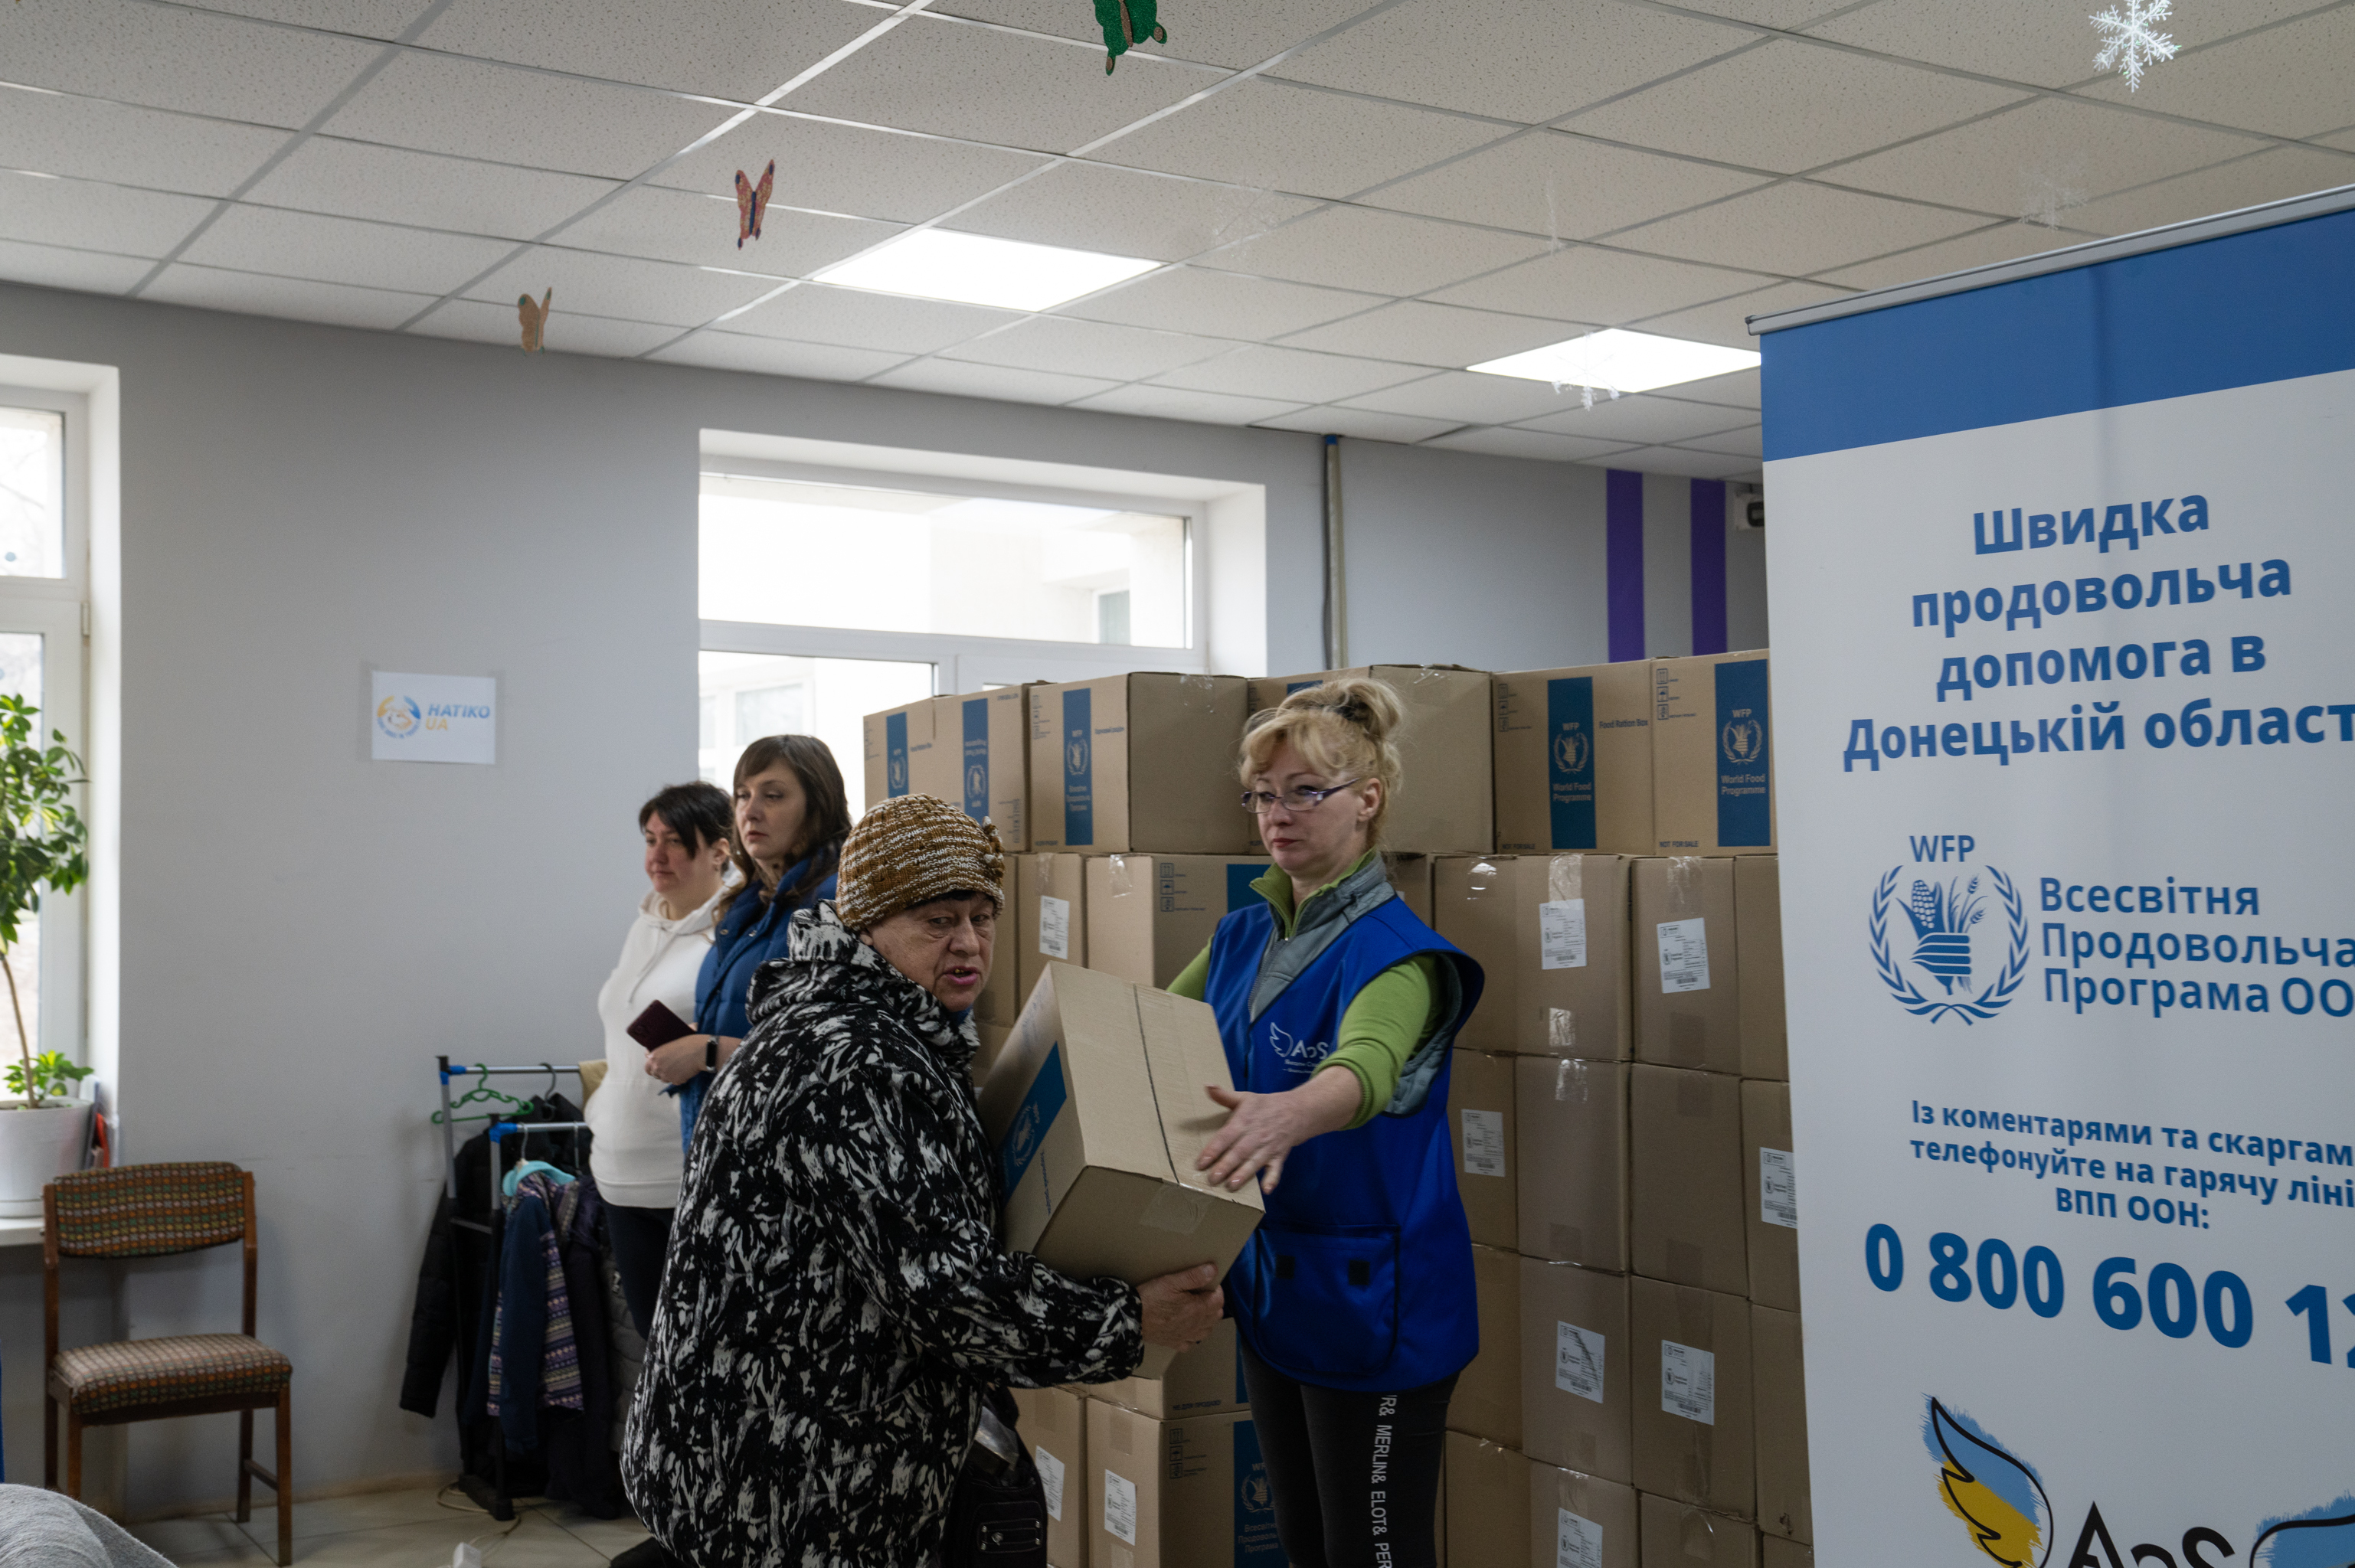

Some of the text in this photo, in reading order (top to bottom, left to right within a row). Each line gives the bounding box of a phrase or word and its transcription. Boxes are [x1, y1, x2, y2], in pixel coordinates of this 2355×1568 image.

[1974, 495, 2209, 555] Швидка
[1913, 559, 2291, 639] продовольча
[1936, 635, 2266, 703] допомога в
[426, 718, 448, 730] UA
[428, 704, 490, 718] HATIKO
[1562, 722, 1579, 731] WFP
[1599, 718, 1648, 729] Food Ration Box
[1732, 708, 1752, 718] WFP
[1843, 697, 2355, 773] Донецькій област
[1552, 782, 1592, 792] World Food
[1552, 793, 1592, 804] Programme
[1720, 773, 1766, 784] World Food
[1721, 786, 1766, 797] Programme
[1909, 835, 1975, 863] WFP
[2040, 876, 2259, 916] Всесвітня
[2043, 922, 2355, 969] Продовольча
[2045, 967, 2269, 1018] Програма
[1912, 1099, 2355, 1167] Із коментарями та скаргам
[1909, 1139, 2106, 1180] телефонуйте
[2115, 1161, 2154, 1184] на
[2164, 1165, 2279, 1206] гарячу
[2056, 1187, 2209, 1230] ВПП ООН:
[1864, 1223, 2355, 1370] 0 800 600 1
[1379, 1394, 1398, 1416] R&
[1371, 1425, 1393, 1485] MERLIN&
[1371, 1491, 1388, 1537] ELOT&
